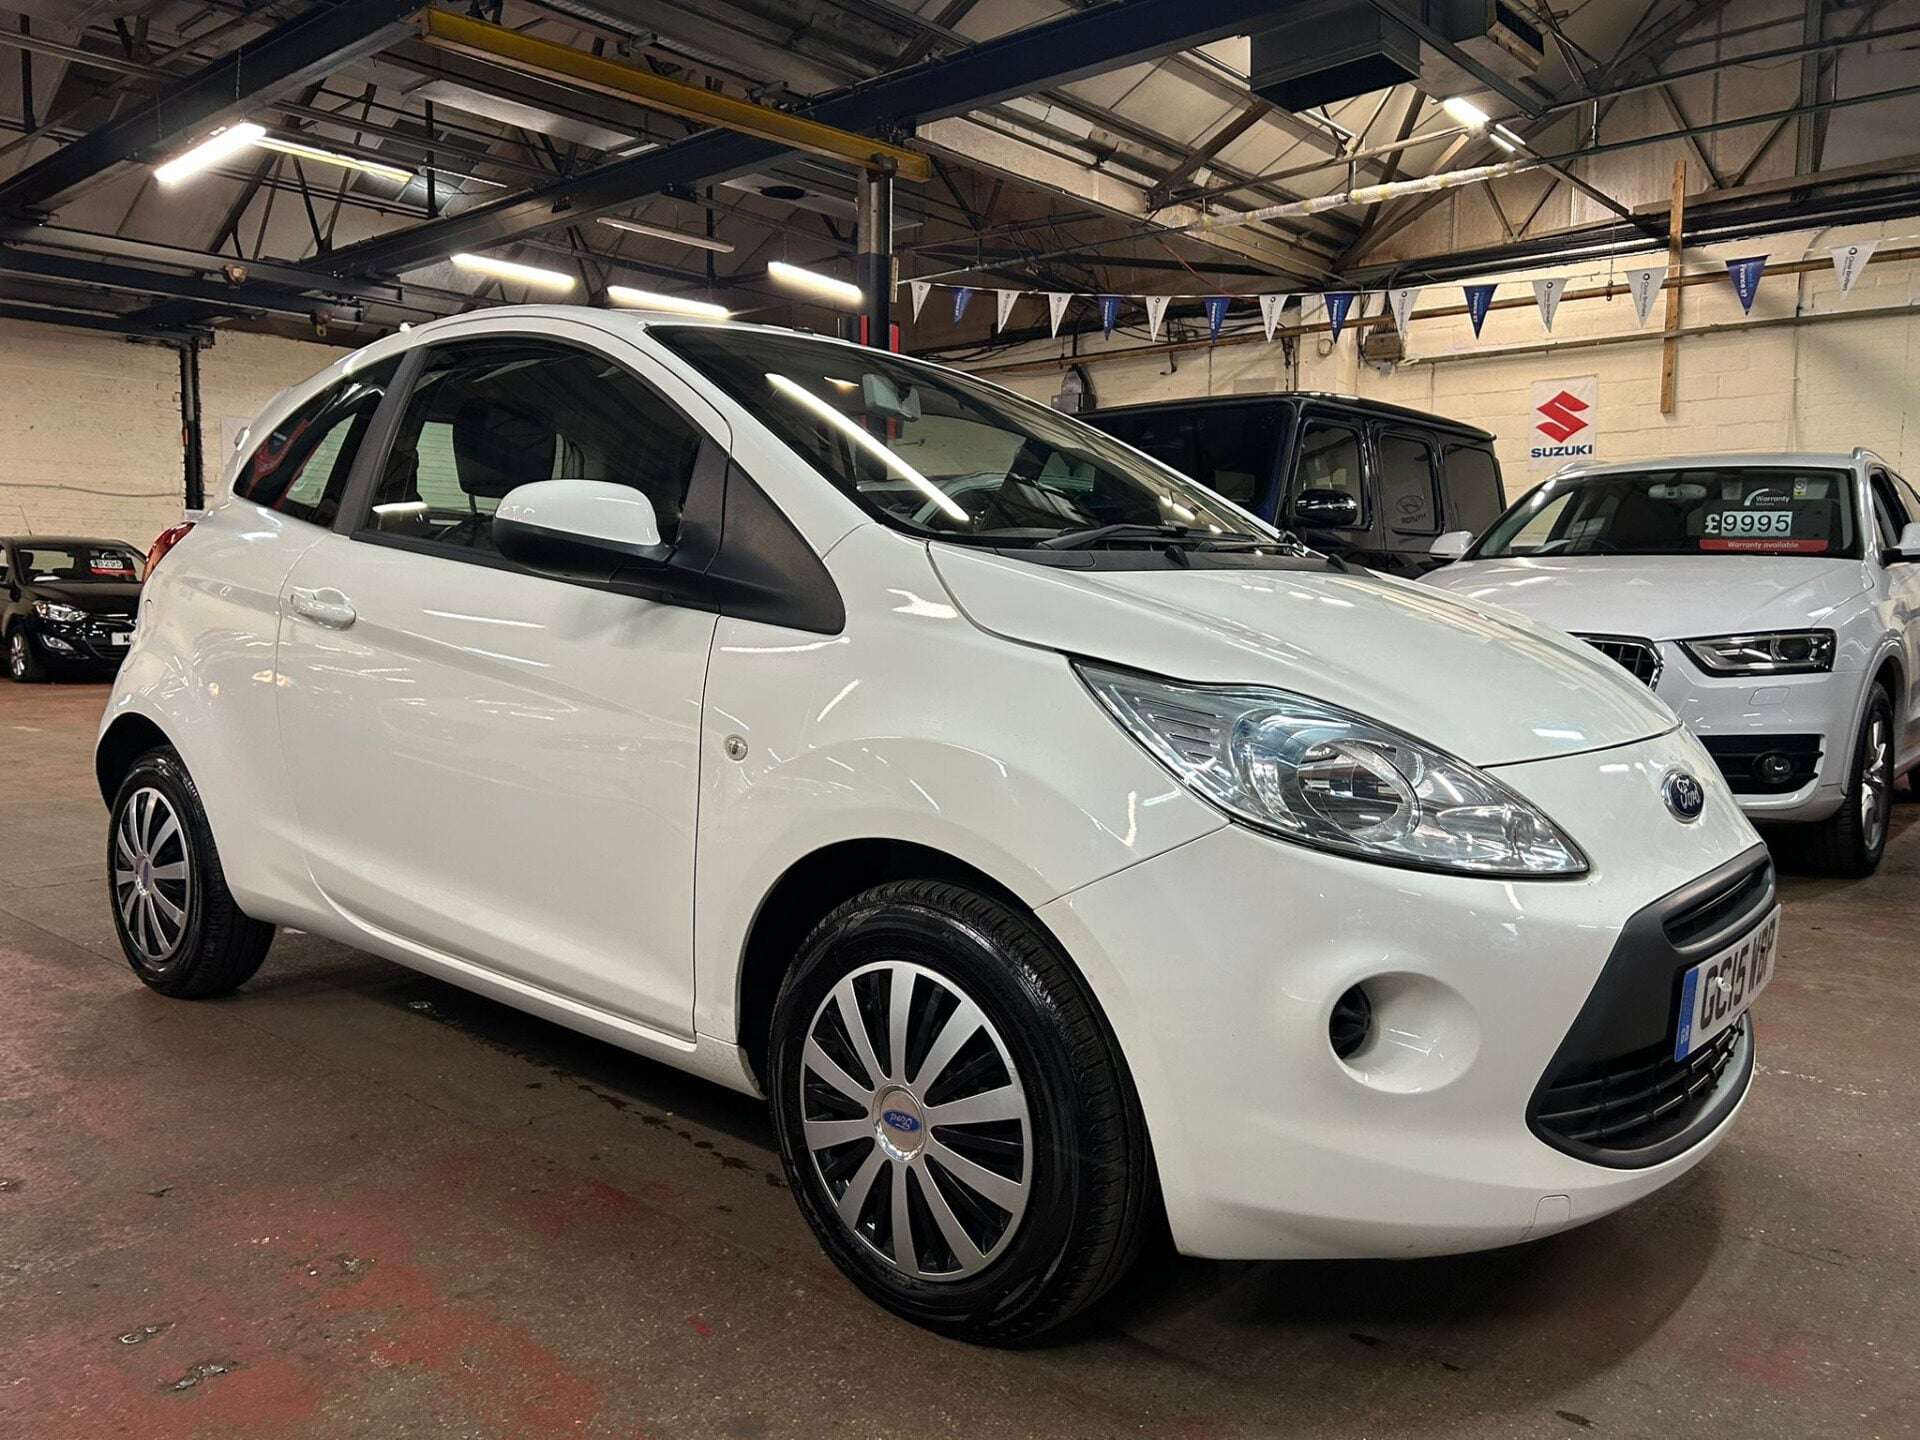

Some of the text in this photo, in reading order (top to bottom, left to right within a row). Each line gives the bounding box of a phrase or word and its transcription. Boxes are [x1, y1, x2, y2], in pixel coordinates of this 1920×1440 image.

[1531, 445, 1592, 458] SUZUKI
[1755, 495, 1790, 504] Warranty
[1704, 513, 1790, 533] £9995
[1727, 540, 1799, 550] Warranty available
[1677, 777, 1700, 809] Ford
[890, 1112, 913, 1130] Ford
